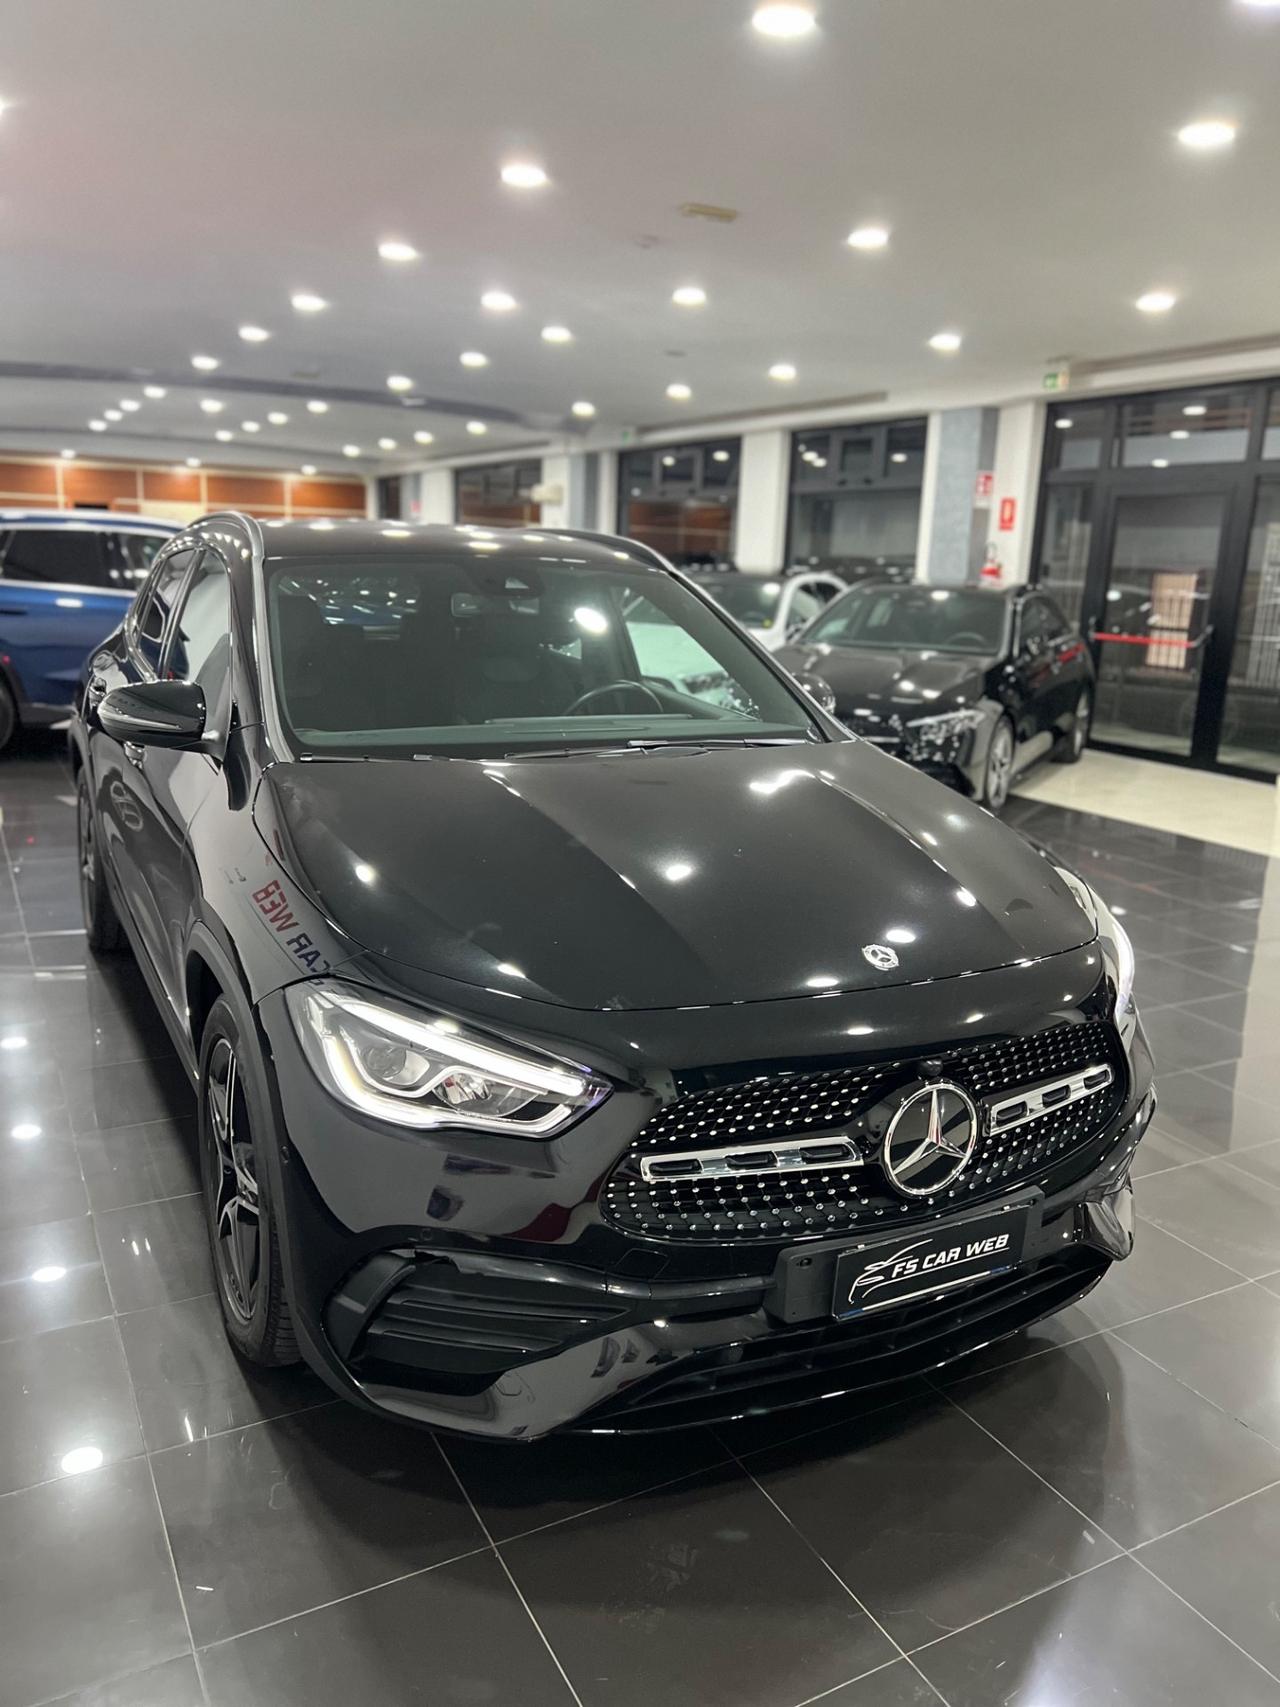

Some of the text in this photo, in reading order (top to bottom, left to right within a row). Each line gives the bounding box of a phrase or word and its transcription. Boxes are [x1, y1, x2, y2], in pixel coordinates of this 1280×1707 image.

[891, 1233, 1010, 1278] FS CAR WEB
